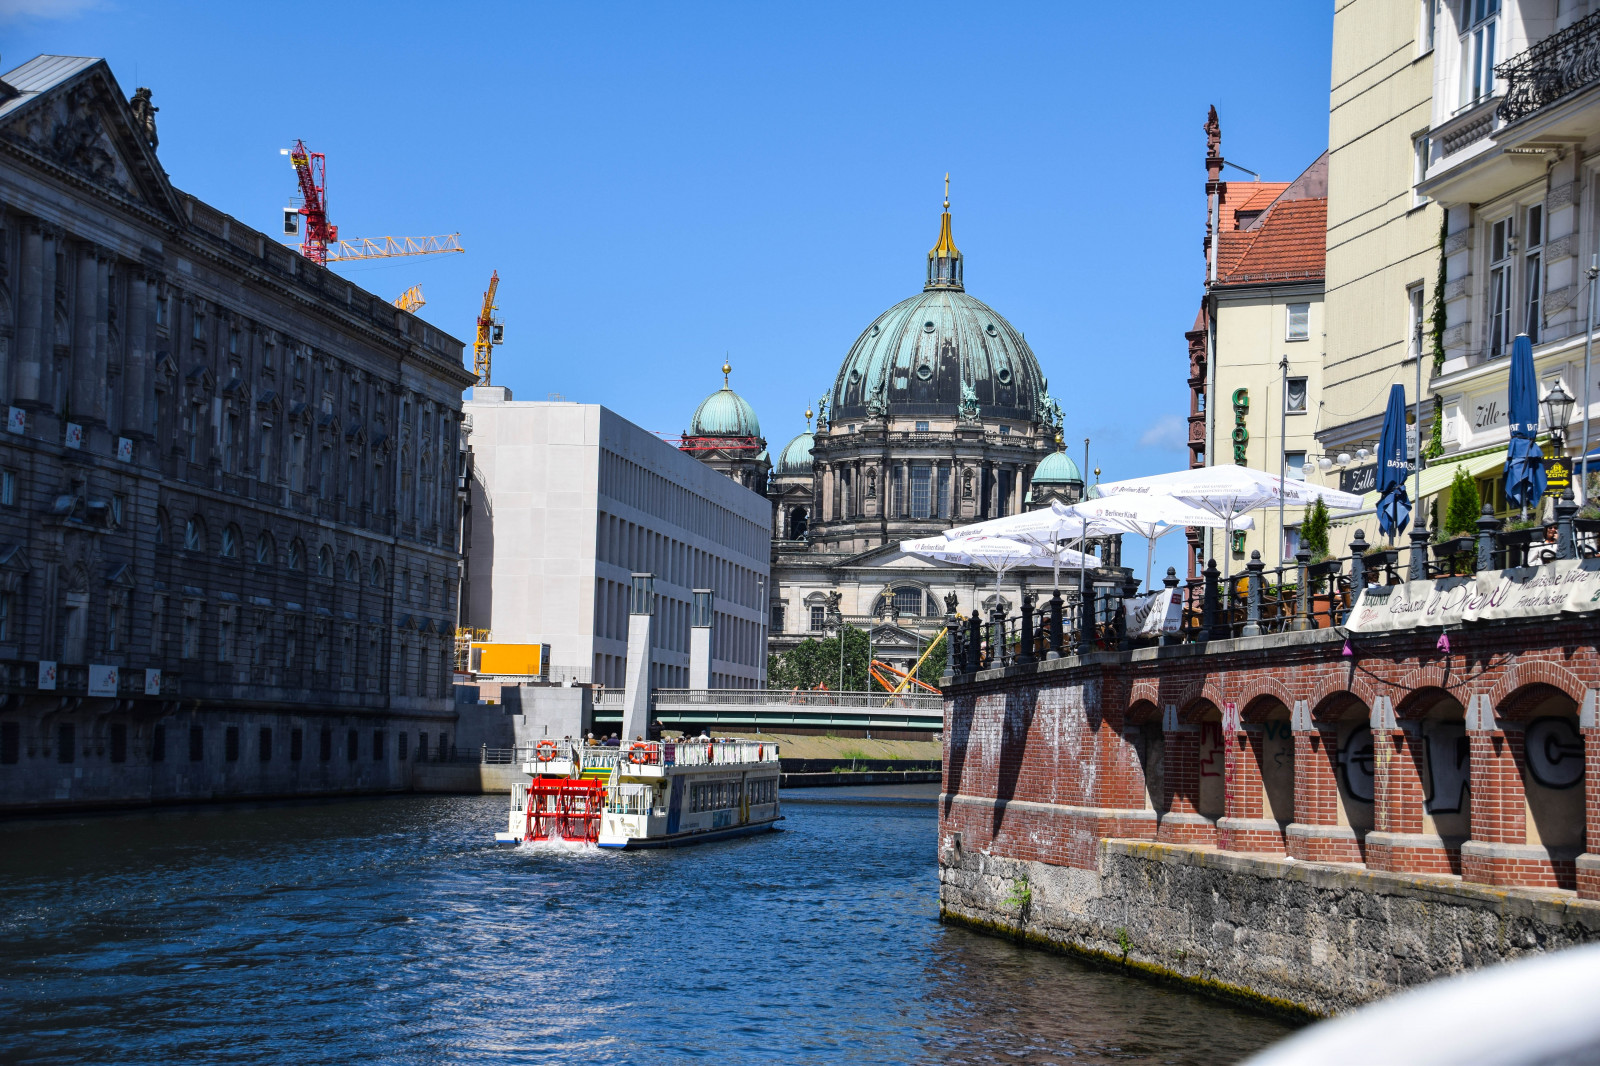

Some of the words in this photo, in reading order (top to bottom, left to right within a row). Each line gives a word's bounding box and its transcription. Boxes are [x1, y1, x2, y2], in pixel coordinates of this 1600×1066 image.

[1352, 469, 1375, 491] Zille
[1105, 509, 1123, 517] Berliner
[1123, 511, 1138, 519] Kindl
[921, 543, 935, 551] Berliner
